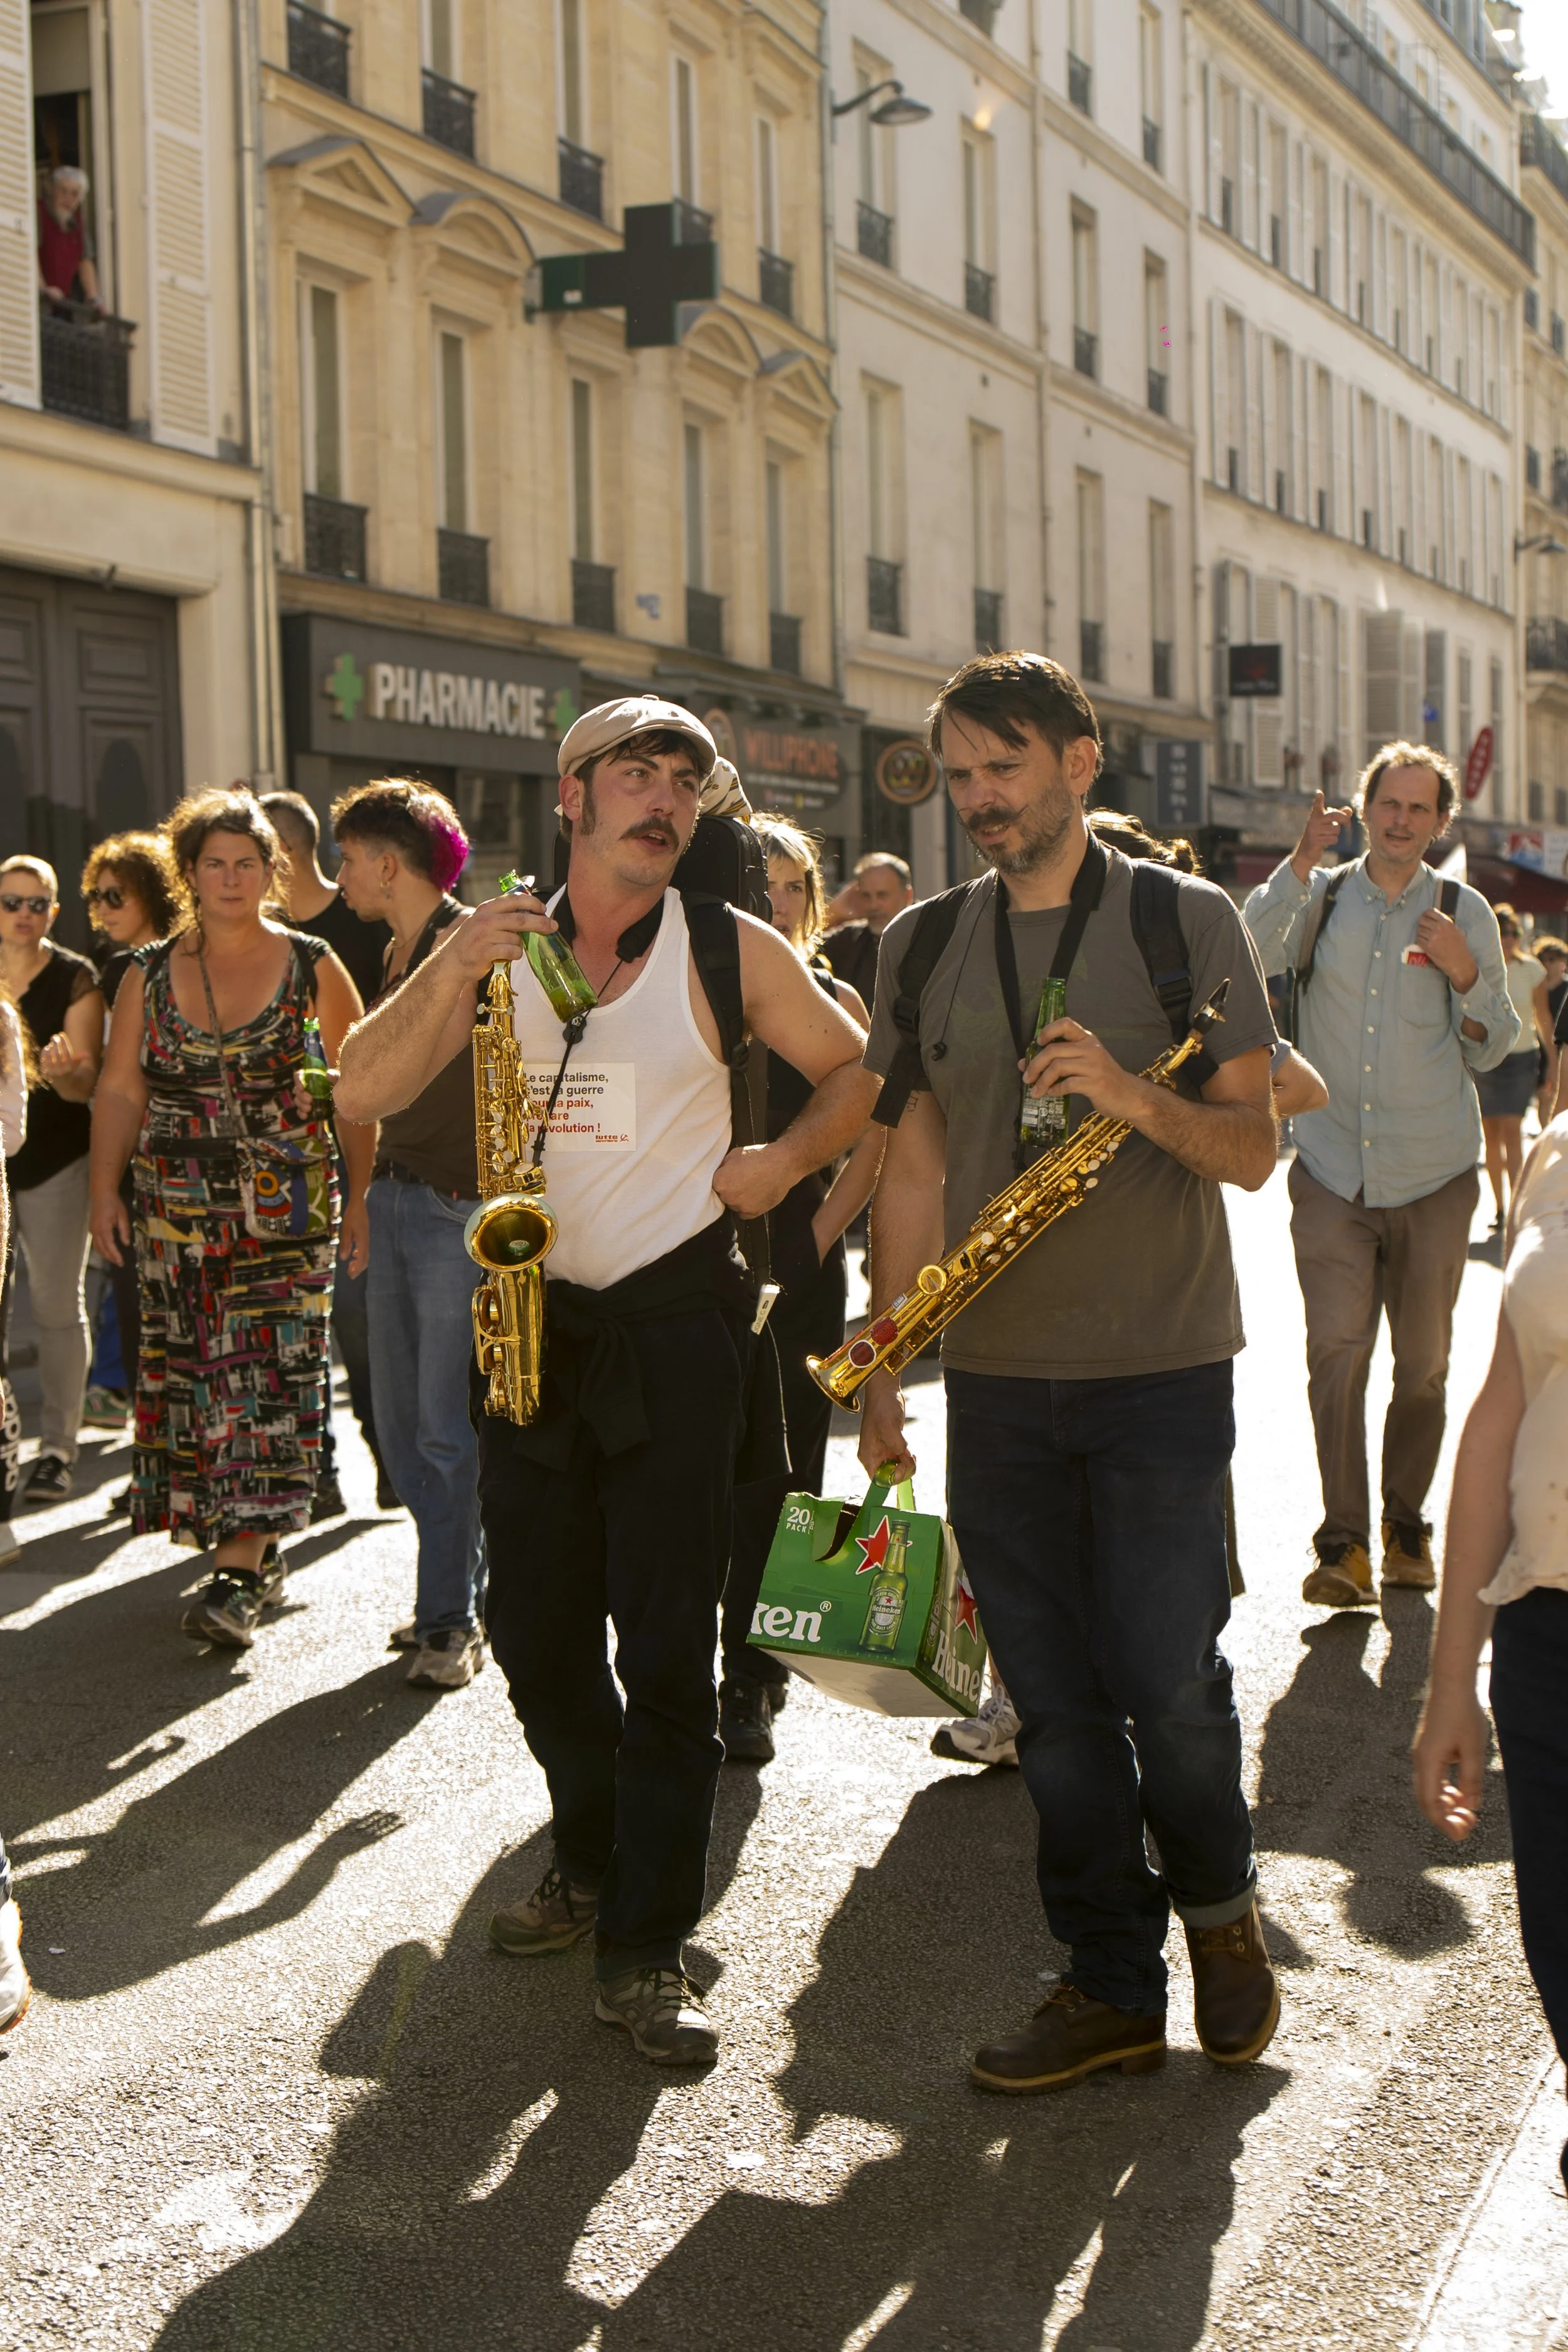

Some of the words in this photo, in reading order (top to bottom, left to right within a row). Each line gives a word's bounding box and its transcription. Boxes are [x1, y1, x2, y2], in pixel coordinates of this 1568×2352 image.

[371, 662, 546, 740] PHARMACIE
[539, 1073, 608, 1084] captalisme,
[566, 1087, 604, 1097] guerre
[566, 1099, 593, 1109] paix,
[538, 1123, 594, 1133] rvolution
[0, 1377, 21, 1491] adidas
[787, 1507, 810, 1525] 20
[786, 1523, 807, 1533] PACK
[872, 1605, 901, 1614] Heineken
[931, 1629, 980, 1705] Heine
